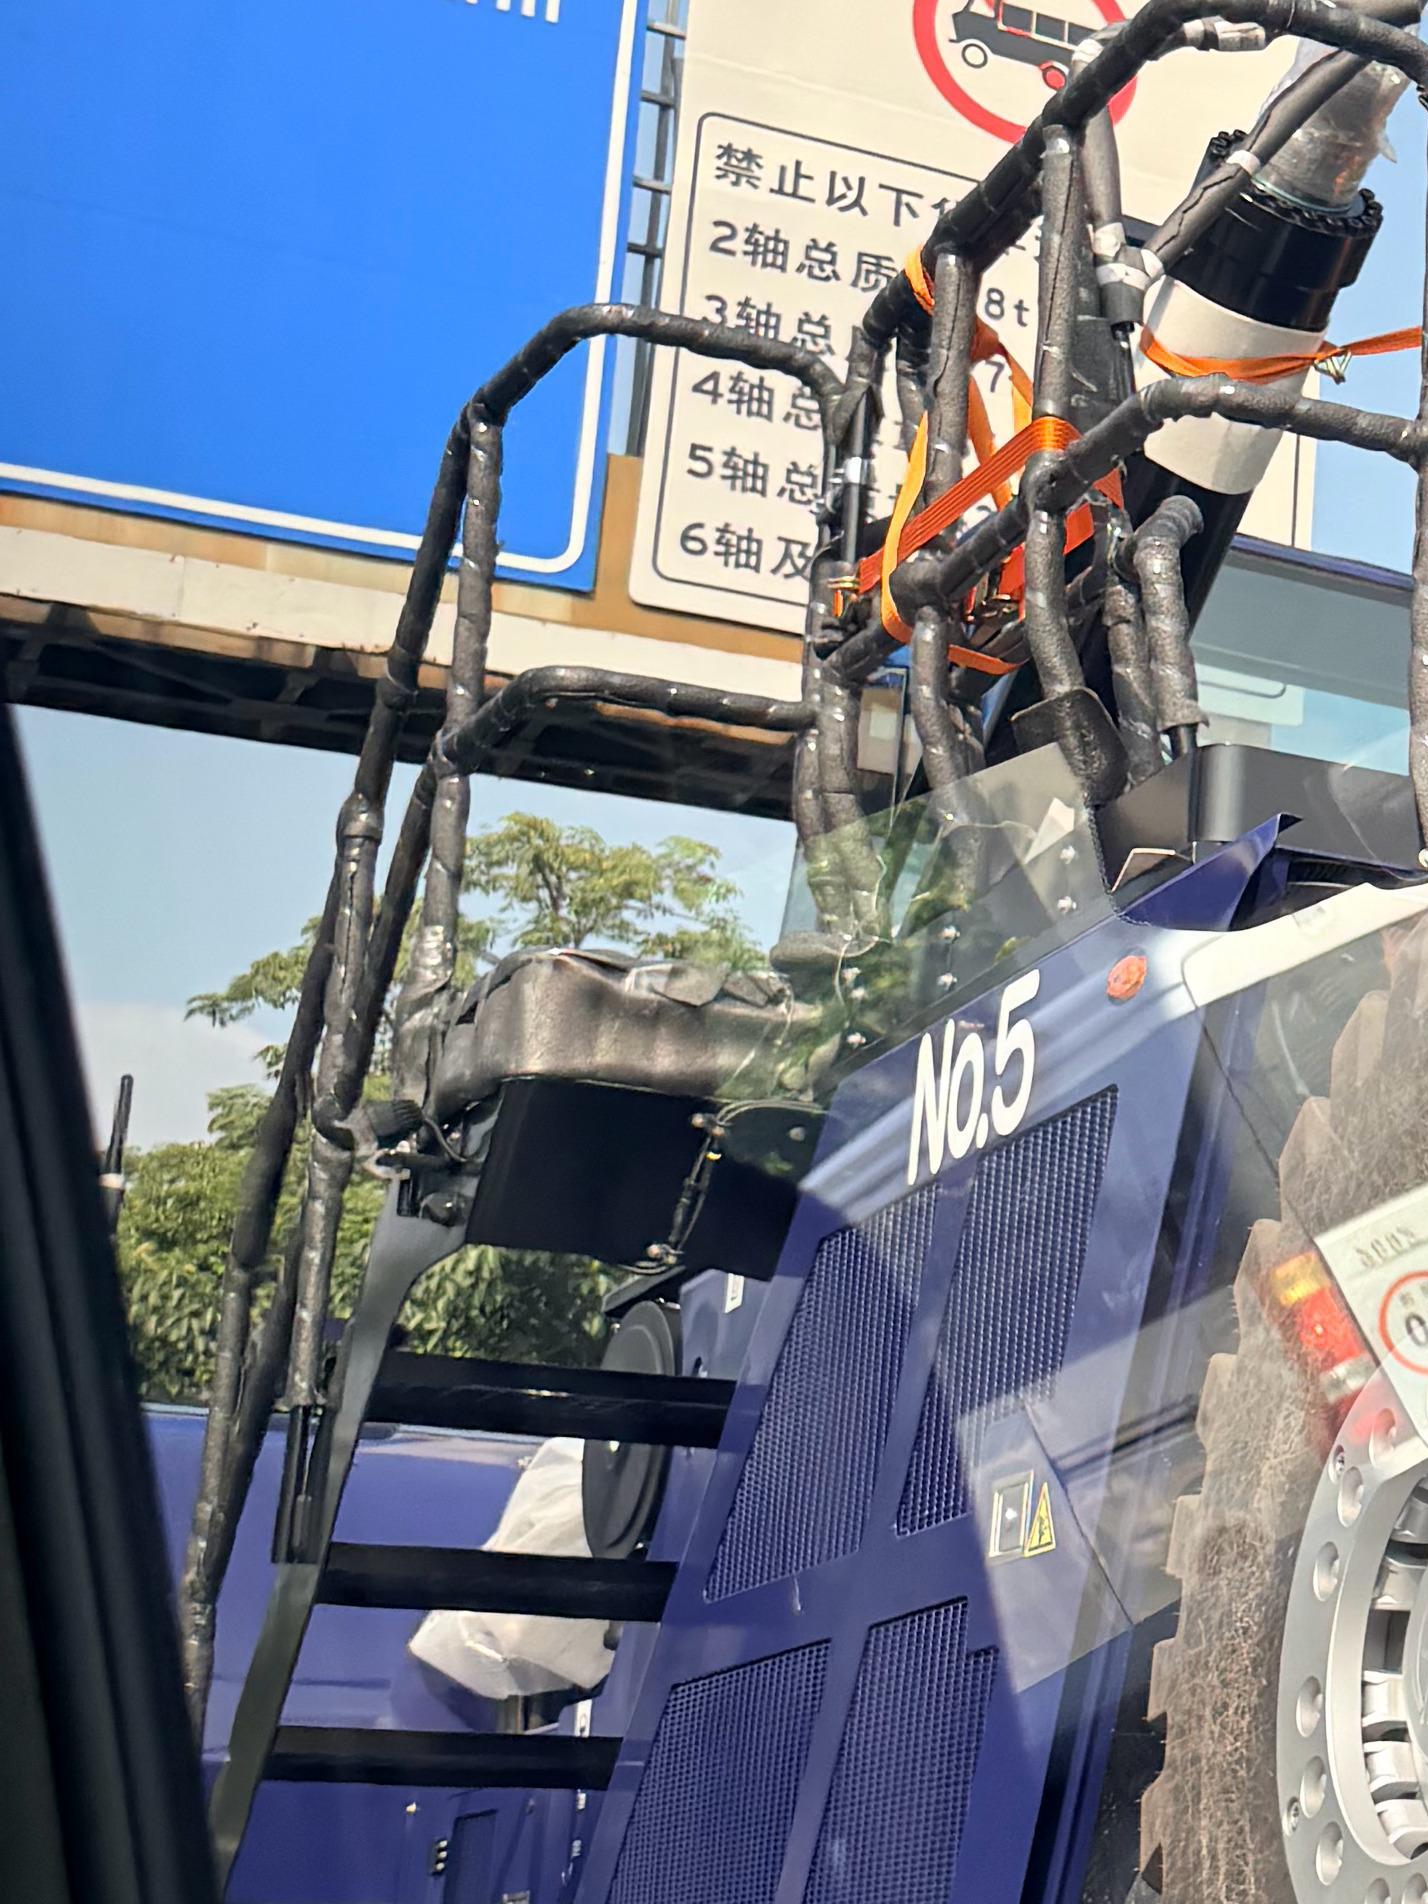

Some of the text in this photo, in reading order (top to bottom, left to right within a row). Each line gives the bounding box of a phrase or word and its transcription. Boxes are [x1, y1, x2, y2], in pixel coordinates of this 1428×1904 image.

[714, 142, 959, 228] 禁止以下
[906, 968, 1041, 1186] No.5
